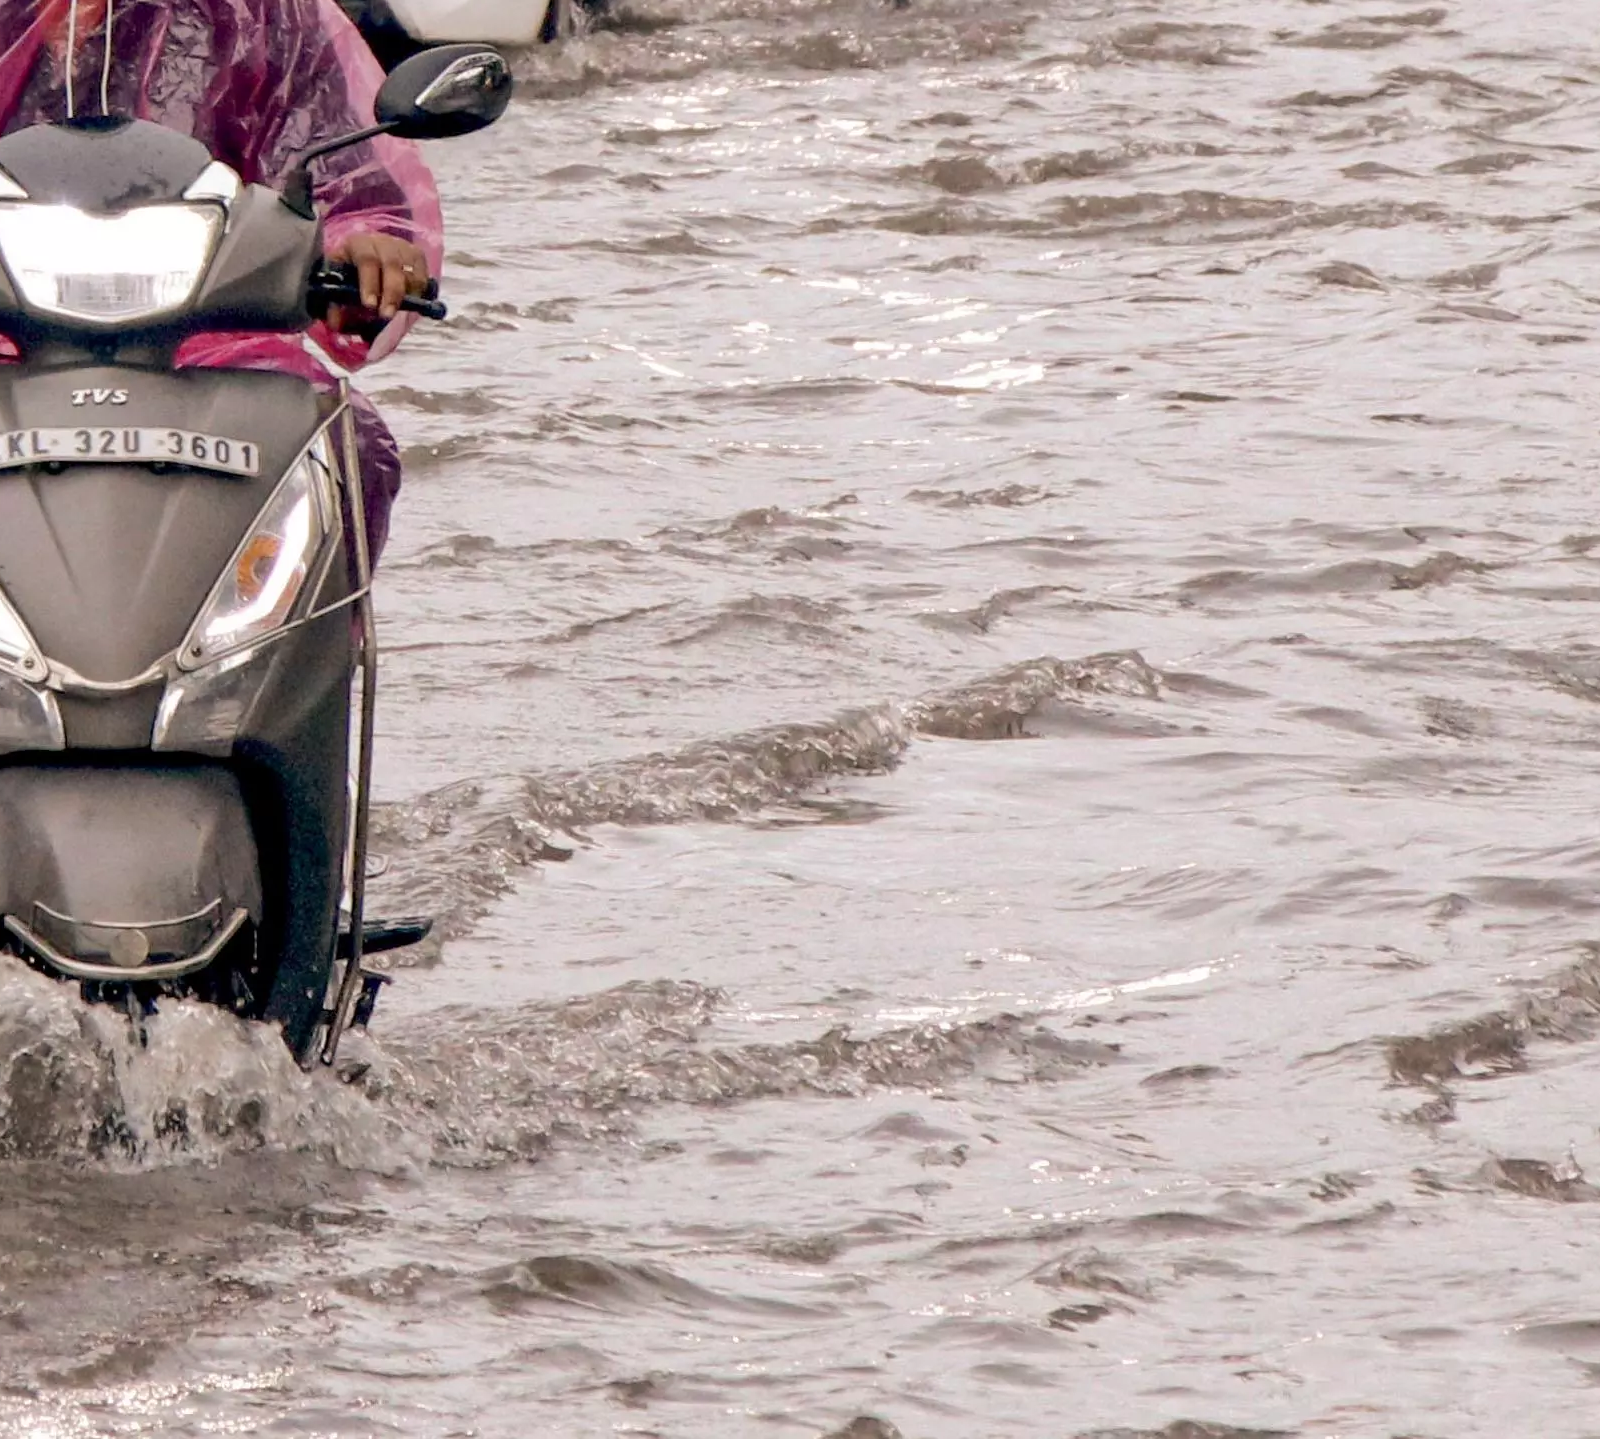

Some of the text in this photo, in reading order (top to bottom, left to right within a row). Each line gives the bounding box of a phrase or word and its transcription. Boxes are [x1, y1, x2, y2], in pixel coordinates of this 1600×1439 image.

[71, 387, 130, 406] TVS
[7, 429, 252, 470] KL 32U 3601
